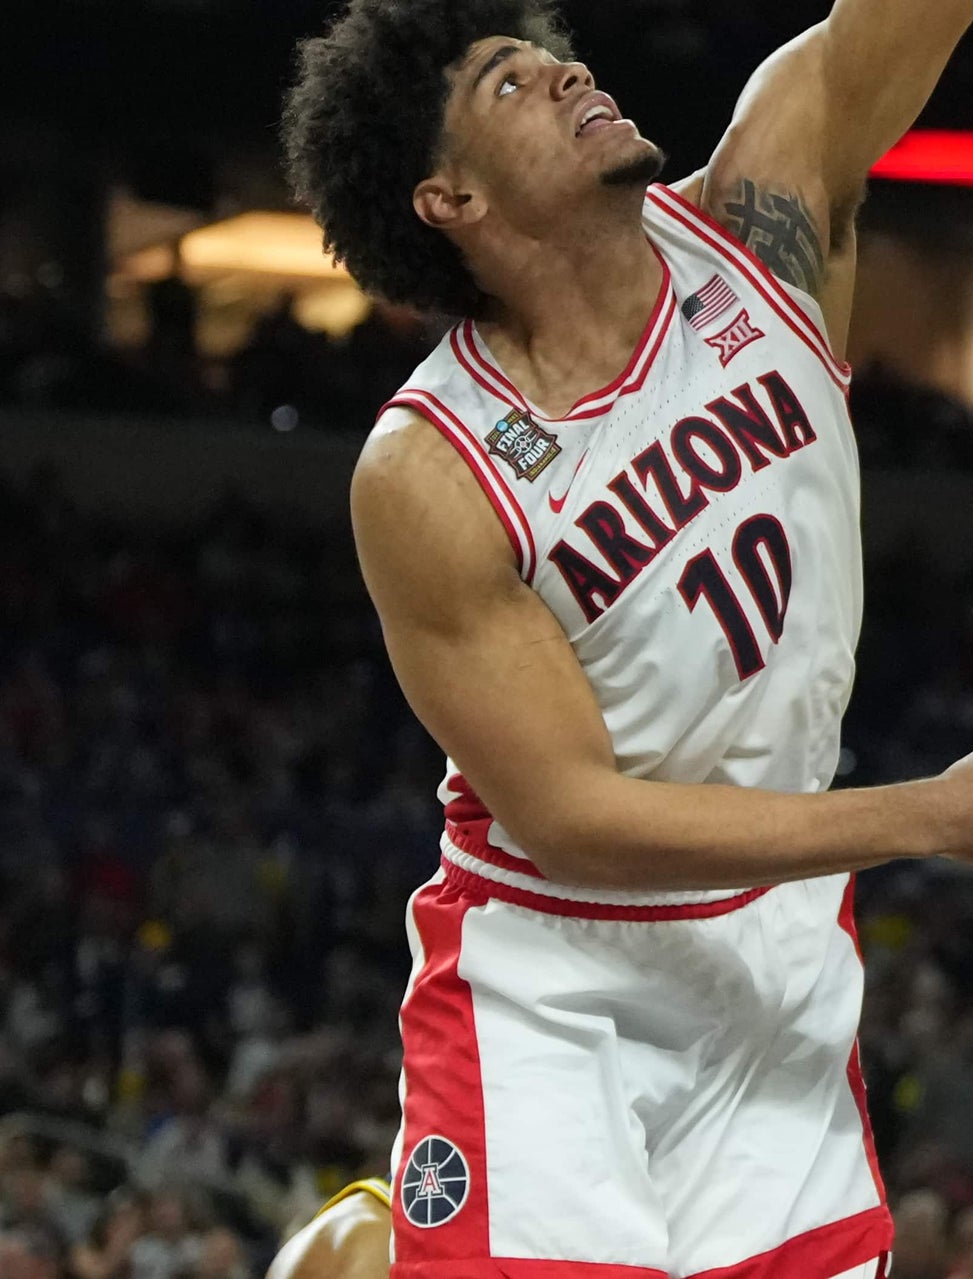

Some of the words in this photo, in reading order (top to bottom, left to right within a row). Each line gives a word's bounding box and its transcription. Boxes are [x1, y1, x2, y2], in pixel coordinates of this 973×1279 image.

[704, 308, 765, 368] XII
[496, 419, 530, 453] FINAL
[517, 437, 550, 470] FOUR
[548, 370, 818, 625] ARIZONA
[676, 513, 793, 681] 10
[417, 1164, 443, 1198] A
